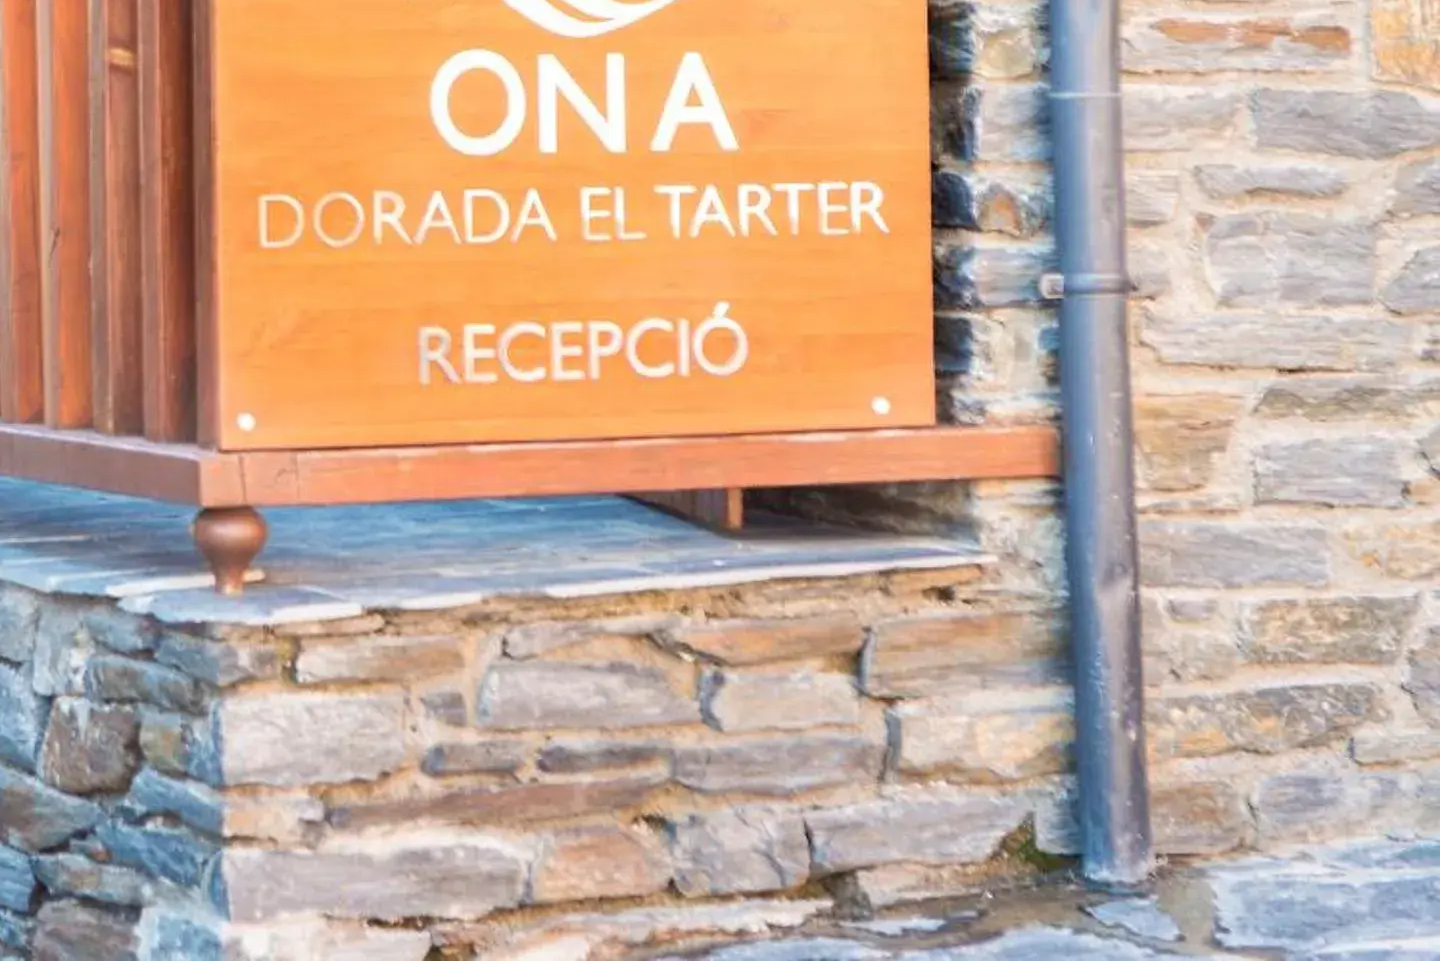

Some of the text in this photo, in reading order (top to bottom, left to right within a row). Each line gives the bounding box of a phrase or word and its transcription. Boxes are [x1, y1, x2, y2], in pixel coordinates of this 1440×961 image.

[430, 48, 740, 156] ONA
[257, 181, 891, 250] DORADA EL TARTER
[416, 301, 749, 386] RECEPCIÓ
